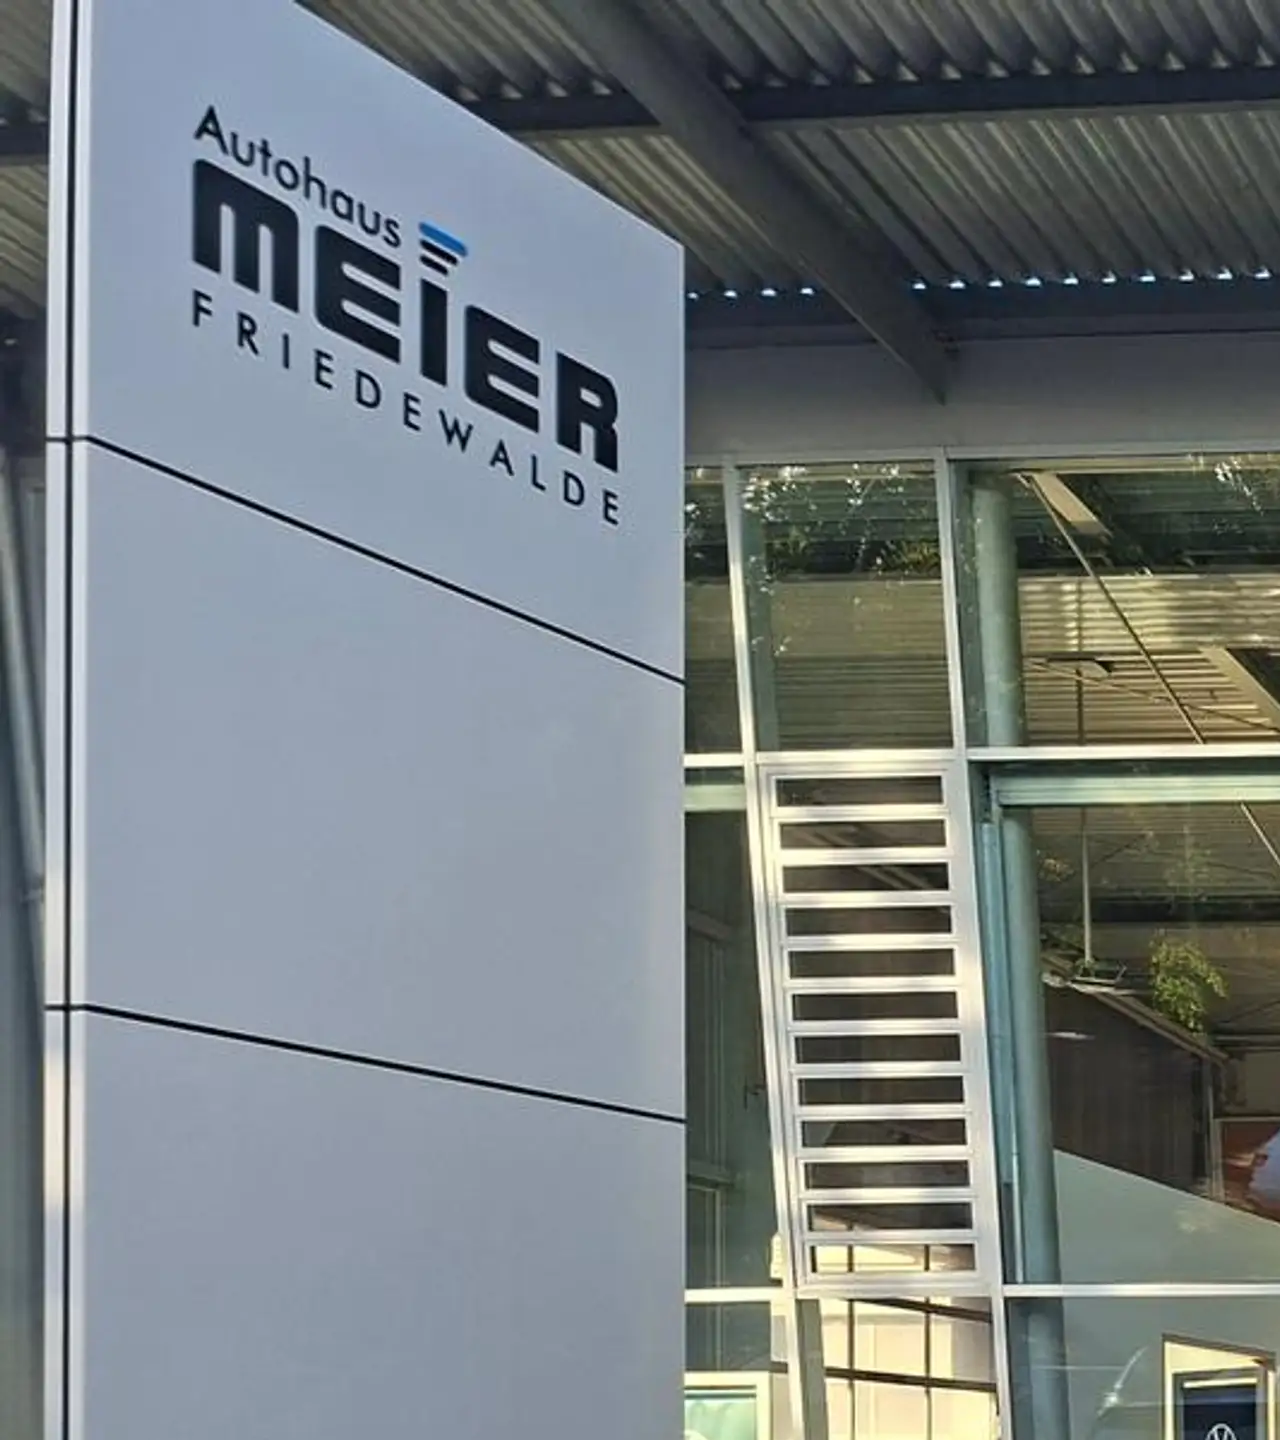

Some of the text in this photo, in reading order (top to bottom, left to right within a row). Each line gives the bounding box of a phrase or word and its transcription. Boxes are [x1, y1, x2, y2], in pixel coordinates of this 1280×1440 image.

[194, 105, 402, 250] Autohaus
[192, 158, 620, 473] MEIER
[192, 290, 621, 527] FRIEDEWALDE
